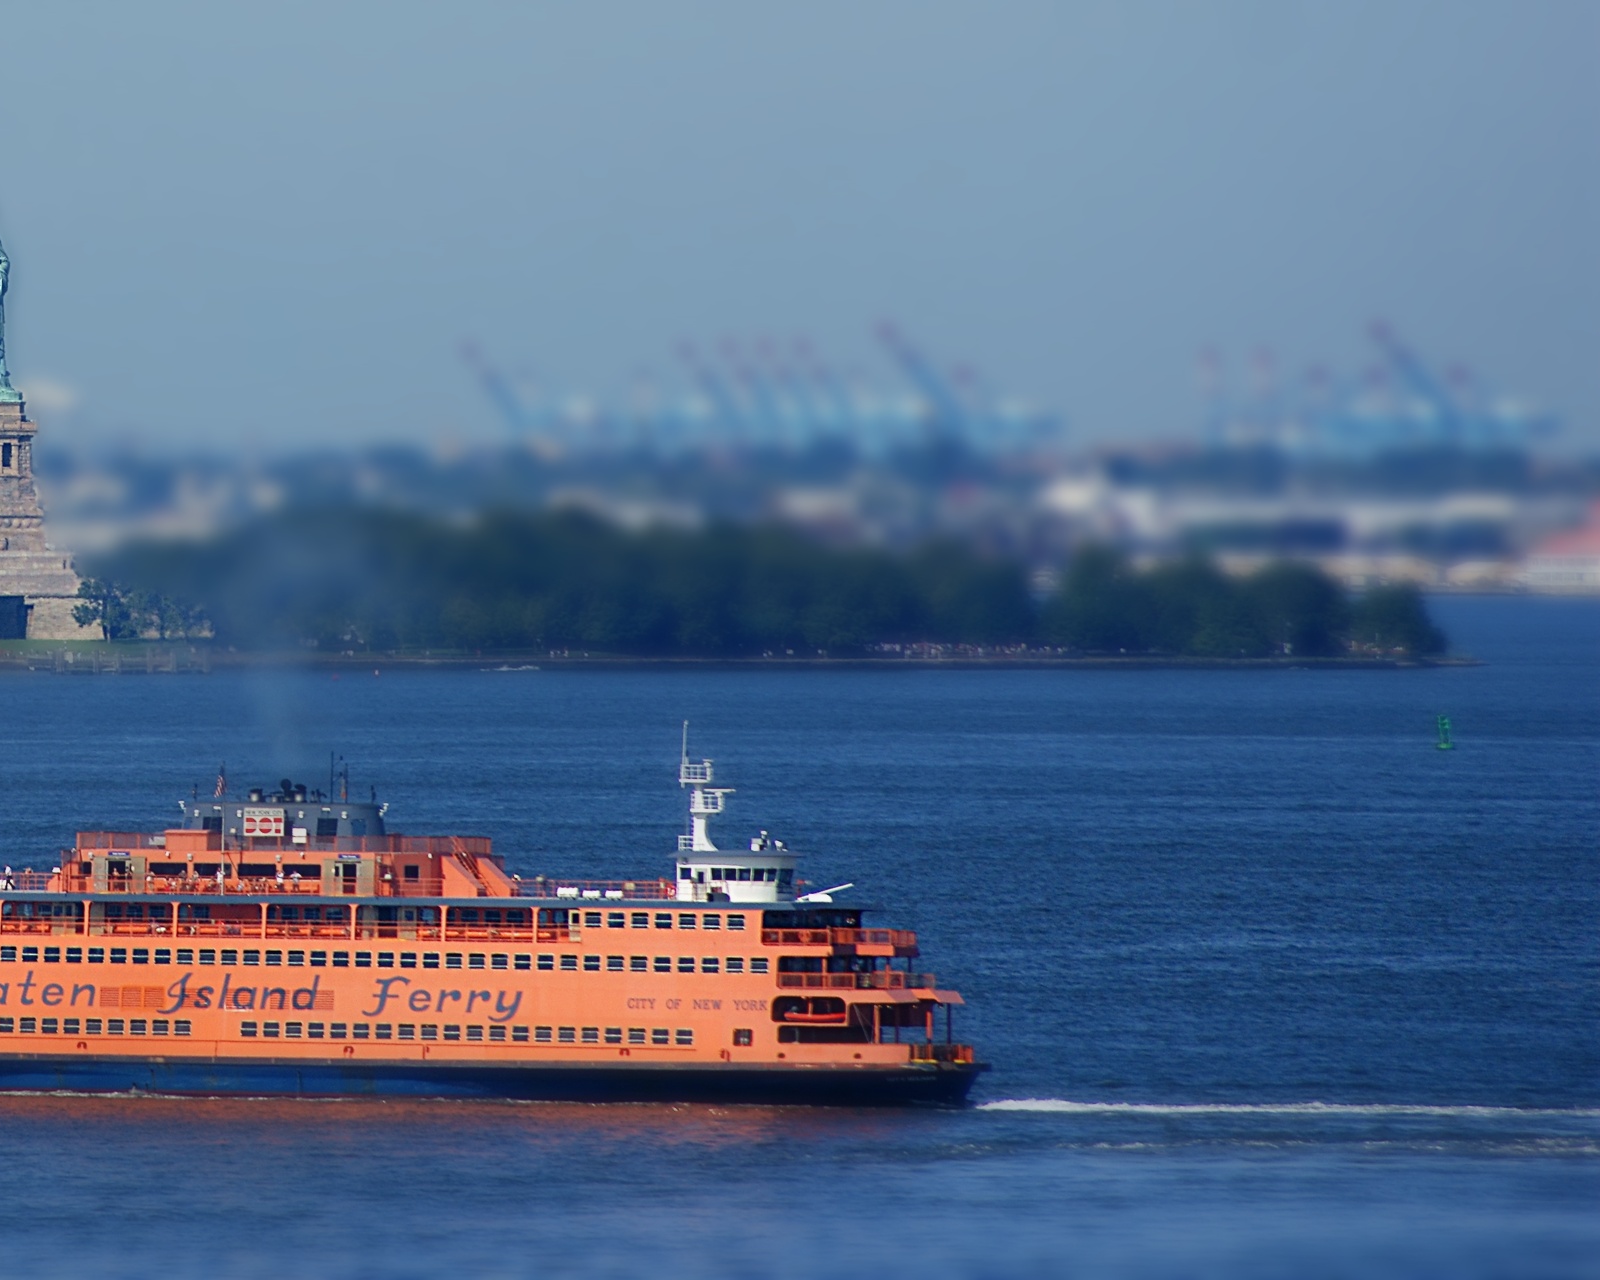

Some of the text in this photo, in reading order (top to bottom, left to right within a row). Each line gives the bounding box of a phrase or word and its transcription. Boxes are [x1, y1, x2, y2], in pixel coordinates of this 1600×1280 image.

[245, 817, 282, 834] DOT
[156, 972, 320, 1014] Island
[362, 975, 523, 1023] Ferry
[627, 998, 767, 1011] CITY OF NEW YORK
